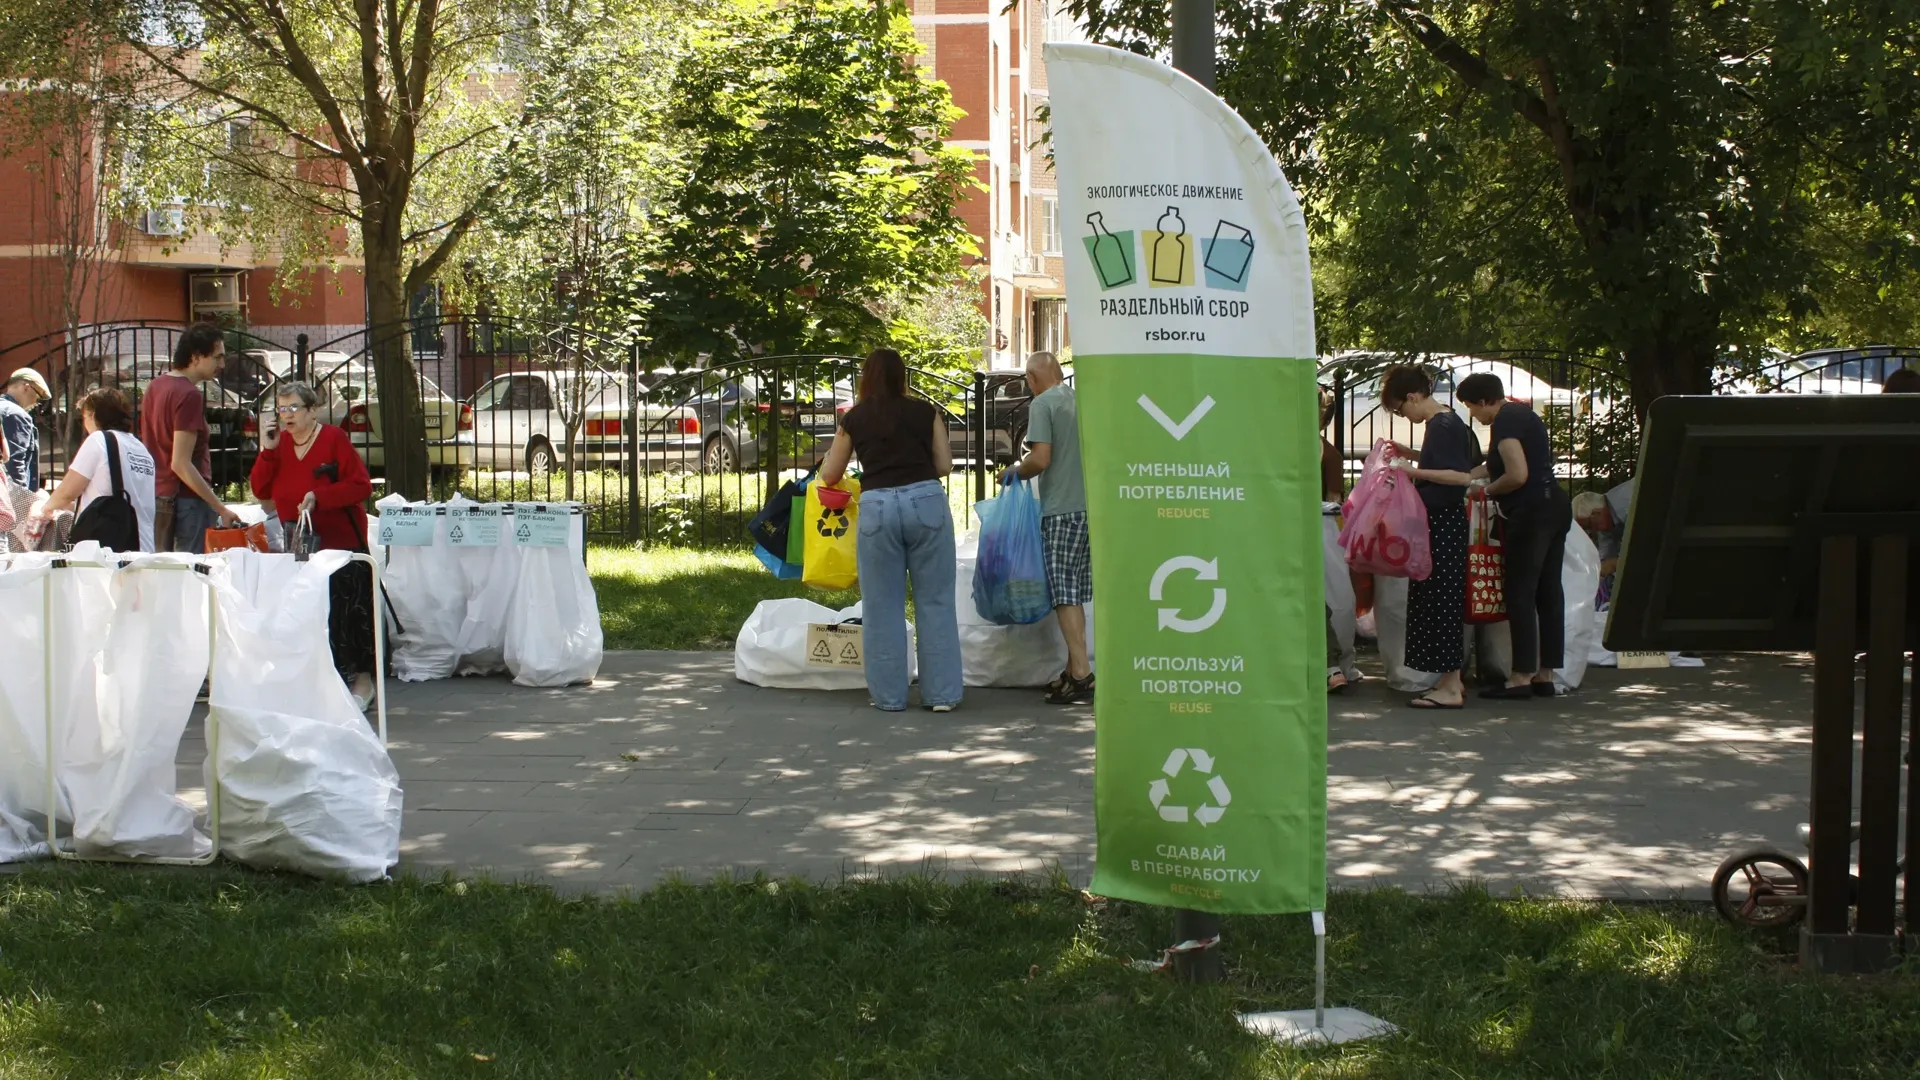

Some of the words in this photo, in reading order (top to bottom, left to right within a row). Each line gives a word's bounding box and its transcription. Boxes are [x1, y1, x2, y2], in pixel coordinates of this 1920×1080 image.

[1087, 184, 1179, 199] ЭКОЛОГИЧЕСКОЕ
[1182, 184, 1243, 200] ДВИЖЕНИЕ
[1101, 296, 1204, 317] РАЗДЕЛЬНЫЙ
[1209, 300, 1249, 318] СБОР
[1145, 328, 1206, 342] rsbor.ru
[1126, 461, 1230, 478] УМЕНЬШАЙ
[1119, 485, 1245, 501] ПОТРЕБЛЕНИЕ
[452, 509, 497, 517] БУТЫЛКИ
[1157, 507, 1210, 519] REDUCE
[816, 626, 858, 635] ПОЛТИЛЕН
[1133, 655, 1244, 672] ИСПОЛЬЗУЙ
[1141, 679, 1242, 694] ПОВТОРНО
[1169, 702, 1212, 713] REUSE
[1156, 844, 1226, 861] СДАВАЙ
[1131, 859, 1140, 872] В
[1144, 861, 1260, 882] ПЕРЕРАБОТКУ
[1170, 883, 1222, 899] RECYCLE
